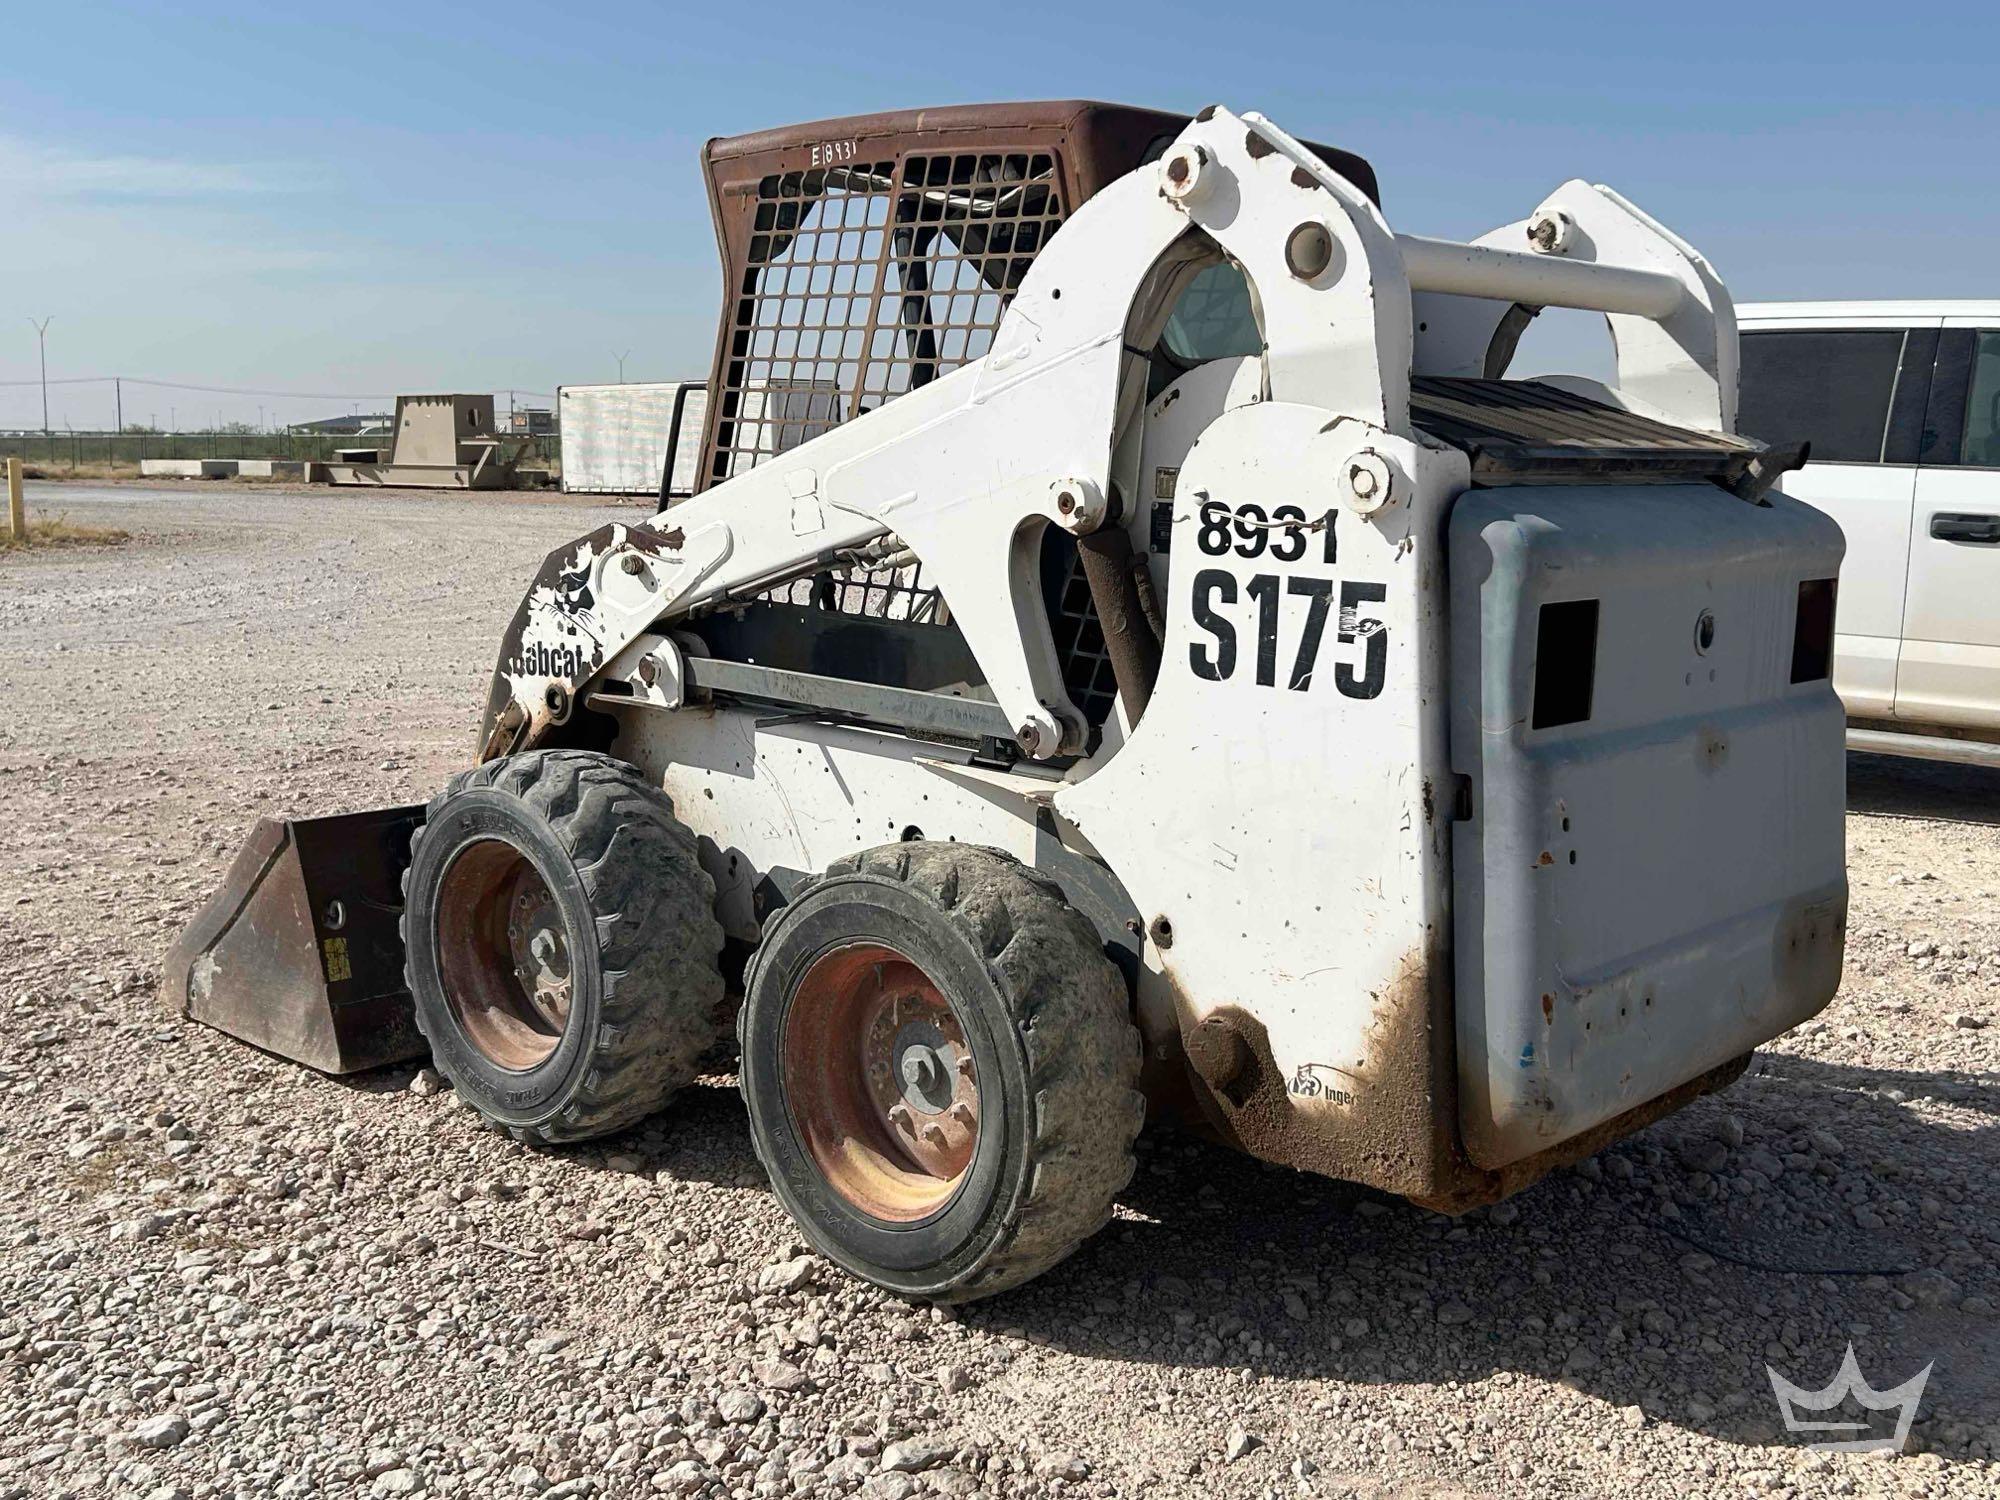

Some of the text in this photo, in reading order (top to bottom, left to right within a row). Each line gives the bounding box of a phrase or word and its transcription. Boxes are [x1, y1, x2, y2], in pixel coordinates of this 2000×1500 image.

[811, 141, 857, 167] E18931
[1197, 501, 1339, 564] 8931
[1189, 568, 1388, 700] S175
